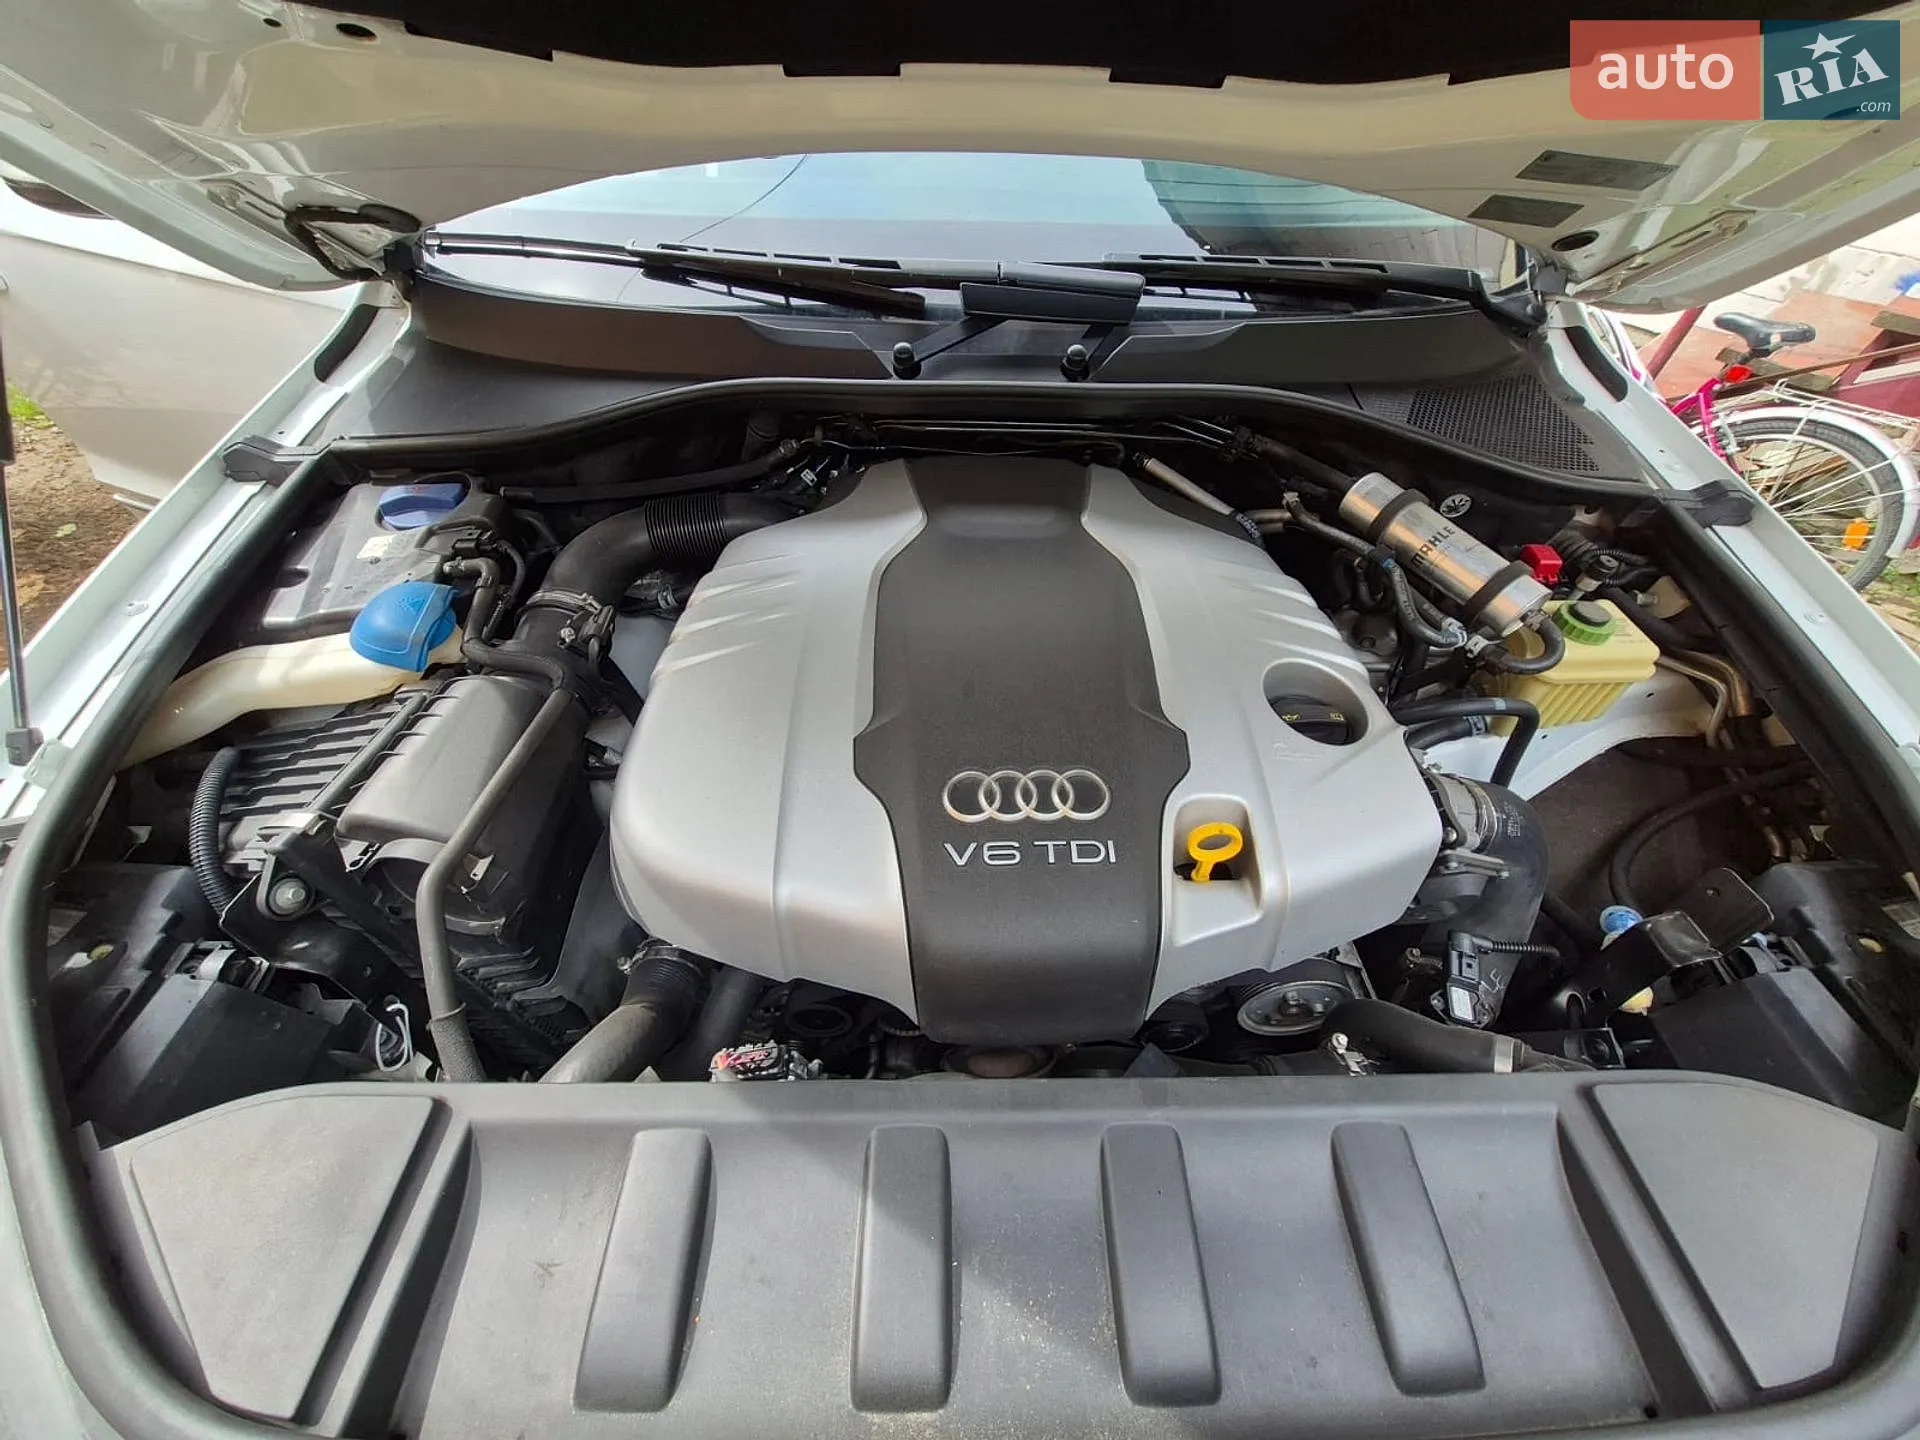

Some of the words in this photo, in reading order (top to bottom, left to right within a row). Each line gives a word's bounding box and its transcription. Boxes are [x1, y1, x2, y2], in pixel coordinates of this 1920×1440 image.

[1410, 526, 1456, 568] MAHLE
[944, 841, 1022, 866] V6
[1033, 839, 1117, 864] TDI
